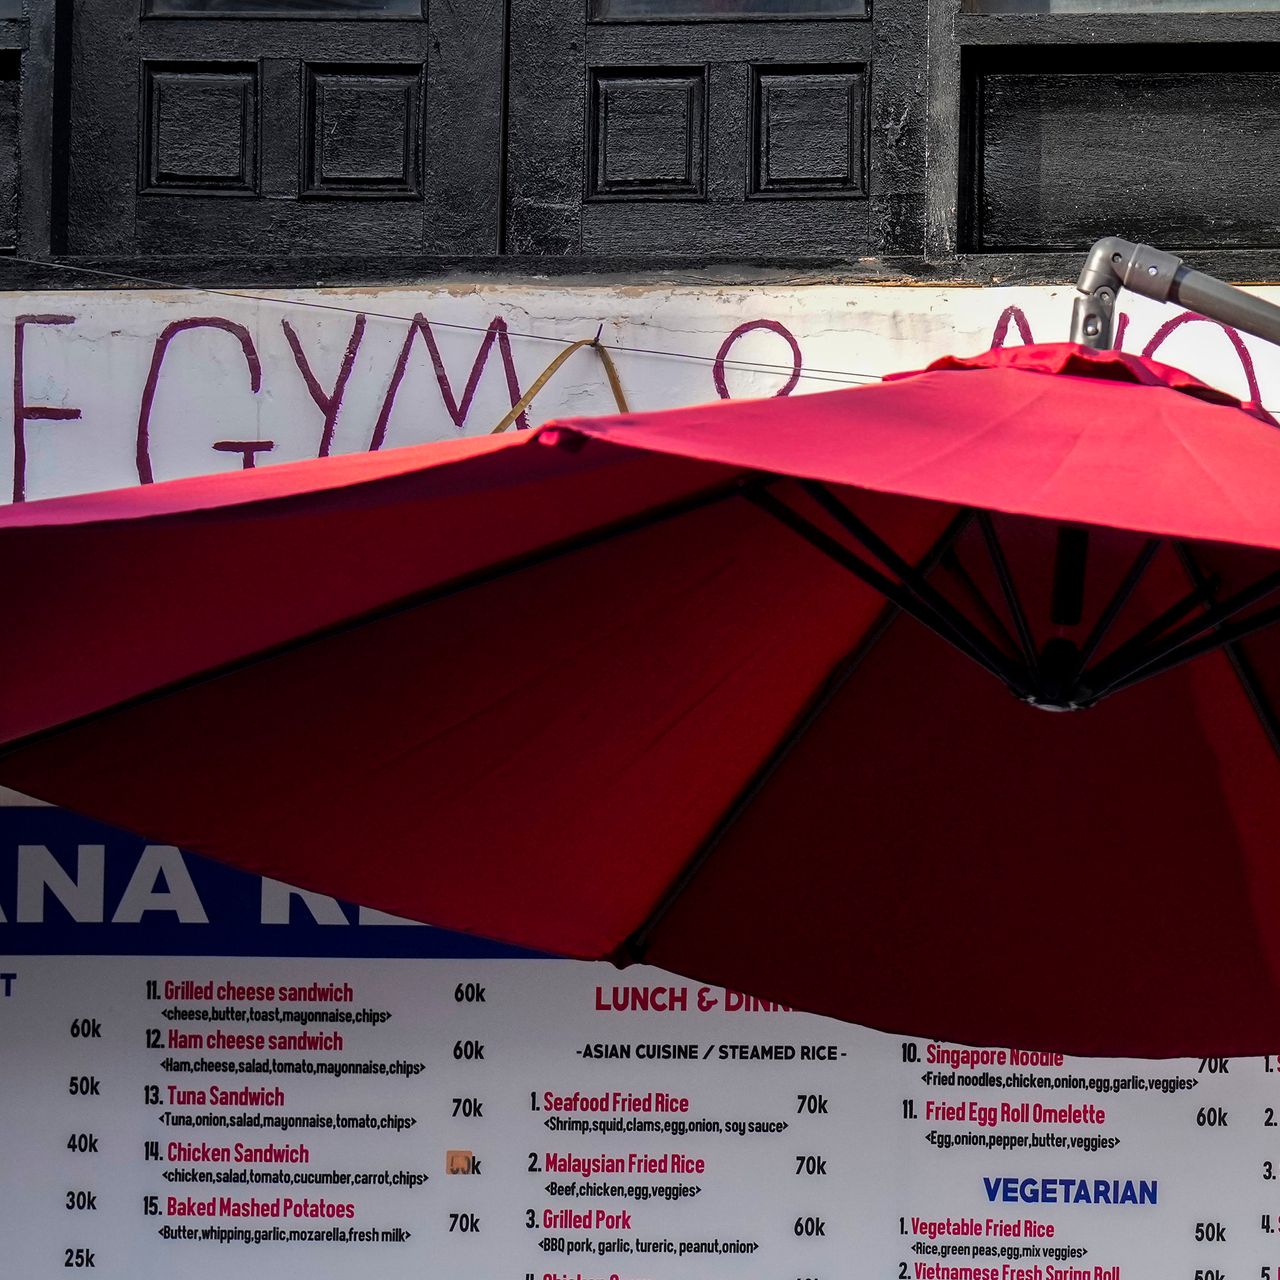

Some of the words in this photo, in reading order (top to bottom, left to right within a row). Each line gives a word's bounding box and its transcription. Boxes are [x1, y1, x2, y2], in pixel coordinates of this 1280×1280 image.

[146, 980, 161, 1000] 11.
[165, 980, 213, 1000] Grilled
[217, 981, 275, 1001] cheese
[278, 982, 353, 1002] sandwich
[454, 983, 486, 1002] 60k
[595, 986, 688, 1012] LUNCH
[697, 986, 719, 1012] &
[70, 1018, 101, 1038] 60k
[453, 1040, 484, 1060] 60k
[635, 1044, 698, 1059] CUISINE
[719, 1045, 795, 1060] STEAMED
[801, 1045, 837, 1060] RICE
[1264, 1055, 1274, 1073] 1.
[69, 1076, 100, 1095] 50k
[144, 1085, 163, 1105] 13.
[167, 1085, 206, 1105] Tuna
[210, 1085, 284, 1106] Sandwich
[531, 1091, 540, 1111] 1.
[544, 1092, 609, 1112] Seafood
[613, 1092, 652, 1112] Fried
[655, 1093, 689, 1112] Rice
[797, 1095, 828, 1114] 70k
[452, 1098, 483, 1117] 70k
[903, 1099, 917, 1119] 11.
[926, 1101, 966, 1121] Fried
[969, 1102, 997, 1127] Egg
[1001, 1103, 1029, 1122] Roll
[1033, 1103, 1105, 1124] Omelette
[1197, 1107, 1228, 1126] 60k
[1264, 1108, 1277, 1126] 2.
[67, 1133, 98, 1152] 40k
[144, 1141, 163, 1161] 14.
[168, 1142, 230, 1162] Chicken
[234, 1143, 309, 1163] Sandwich
[528, 1152, 542, 1172] 2.
[546, 1153, 625, 1177] Malaysian
[629, 1154, 668, 1173] Fried
[671, 1154, 705, 1173] Rice
[796, 1156, 826, 1175] 70k
[1263, 1161, 1276, 1180] 3.
[983, 1177, 1157, 1204] VEGETARIAN
[66, 1191, 97, 1210] 30k
[143, 1196, 162, 1215] 15.
[167, 1197, 216, 1216] Baked
[219, 1197, 280, 1217] Mashed
[283, 1198, 354, 1218] Potatoes
[449, 1213, 480, 1232] 70k
[794, 1217, 825, 1236] 60k
[900, 1217, 908, 1235] 1.
[911, 1217, 982, 1239] Vegetable
[986, 1219, 1021, 1237] Fried
[1024, 1220, 1054, 1237] Rice
[1195, 1222, 1226, 1242] 50k
[65, 1248, 95, 1267] 25k
